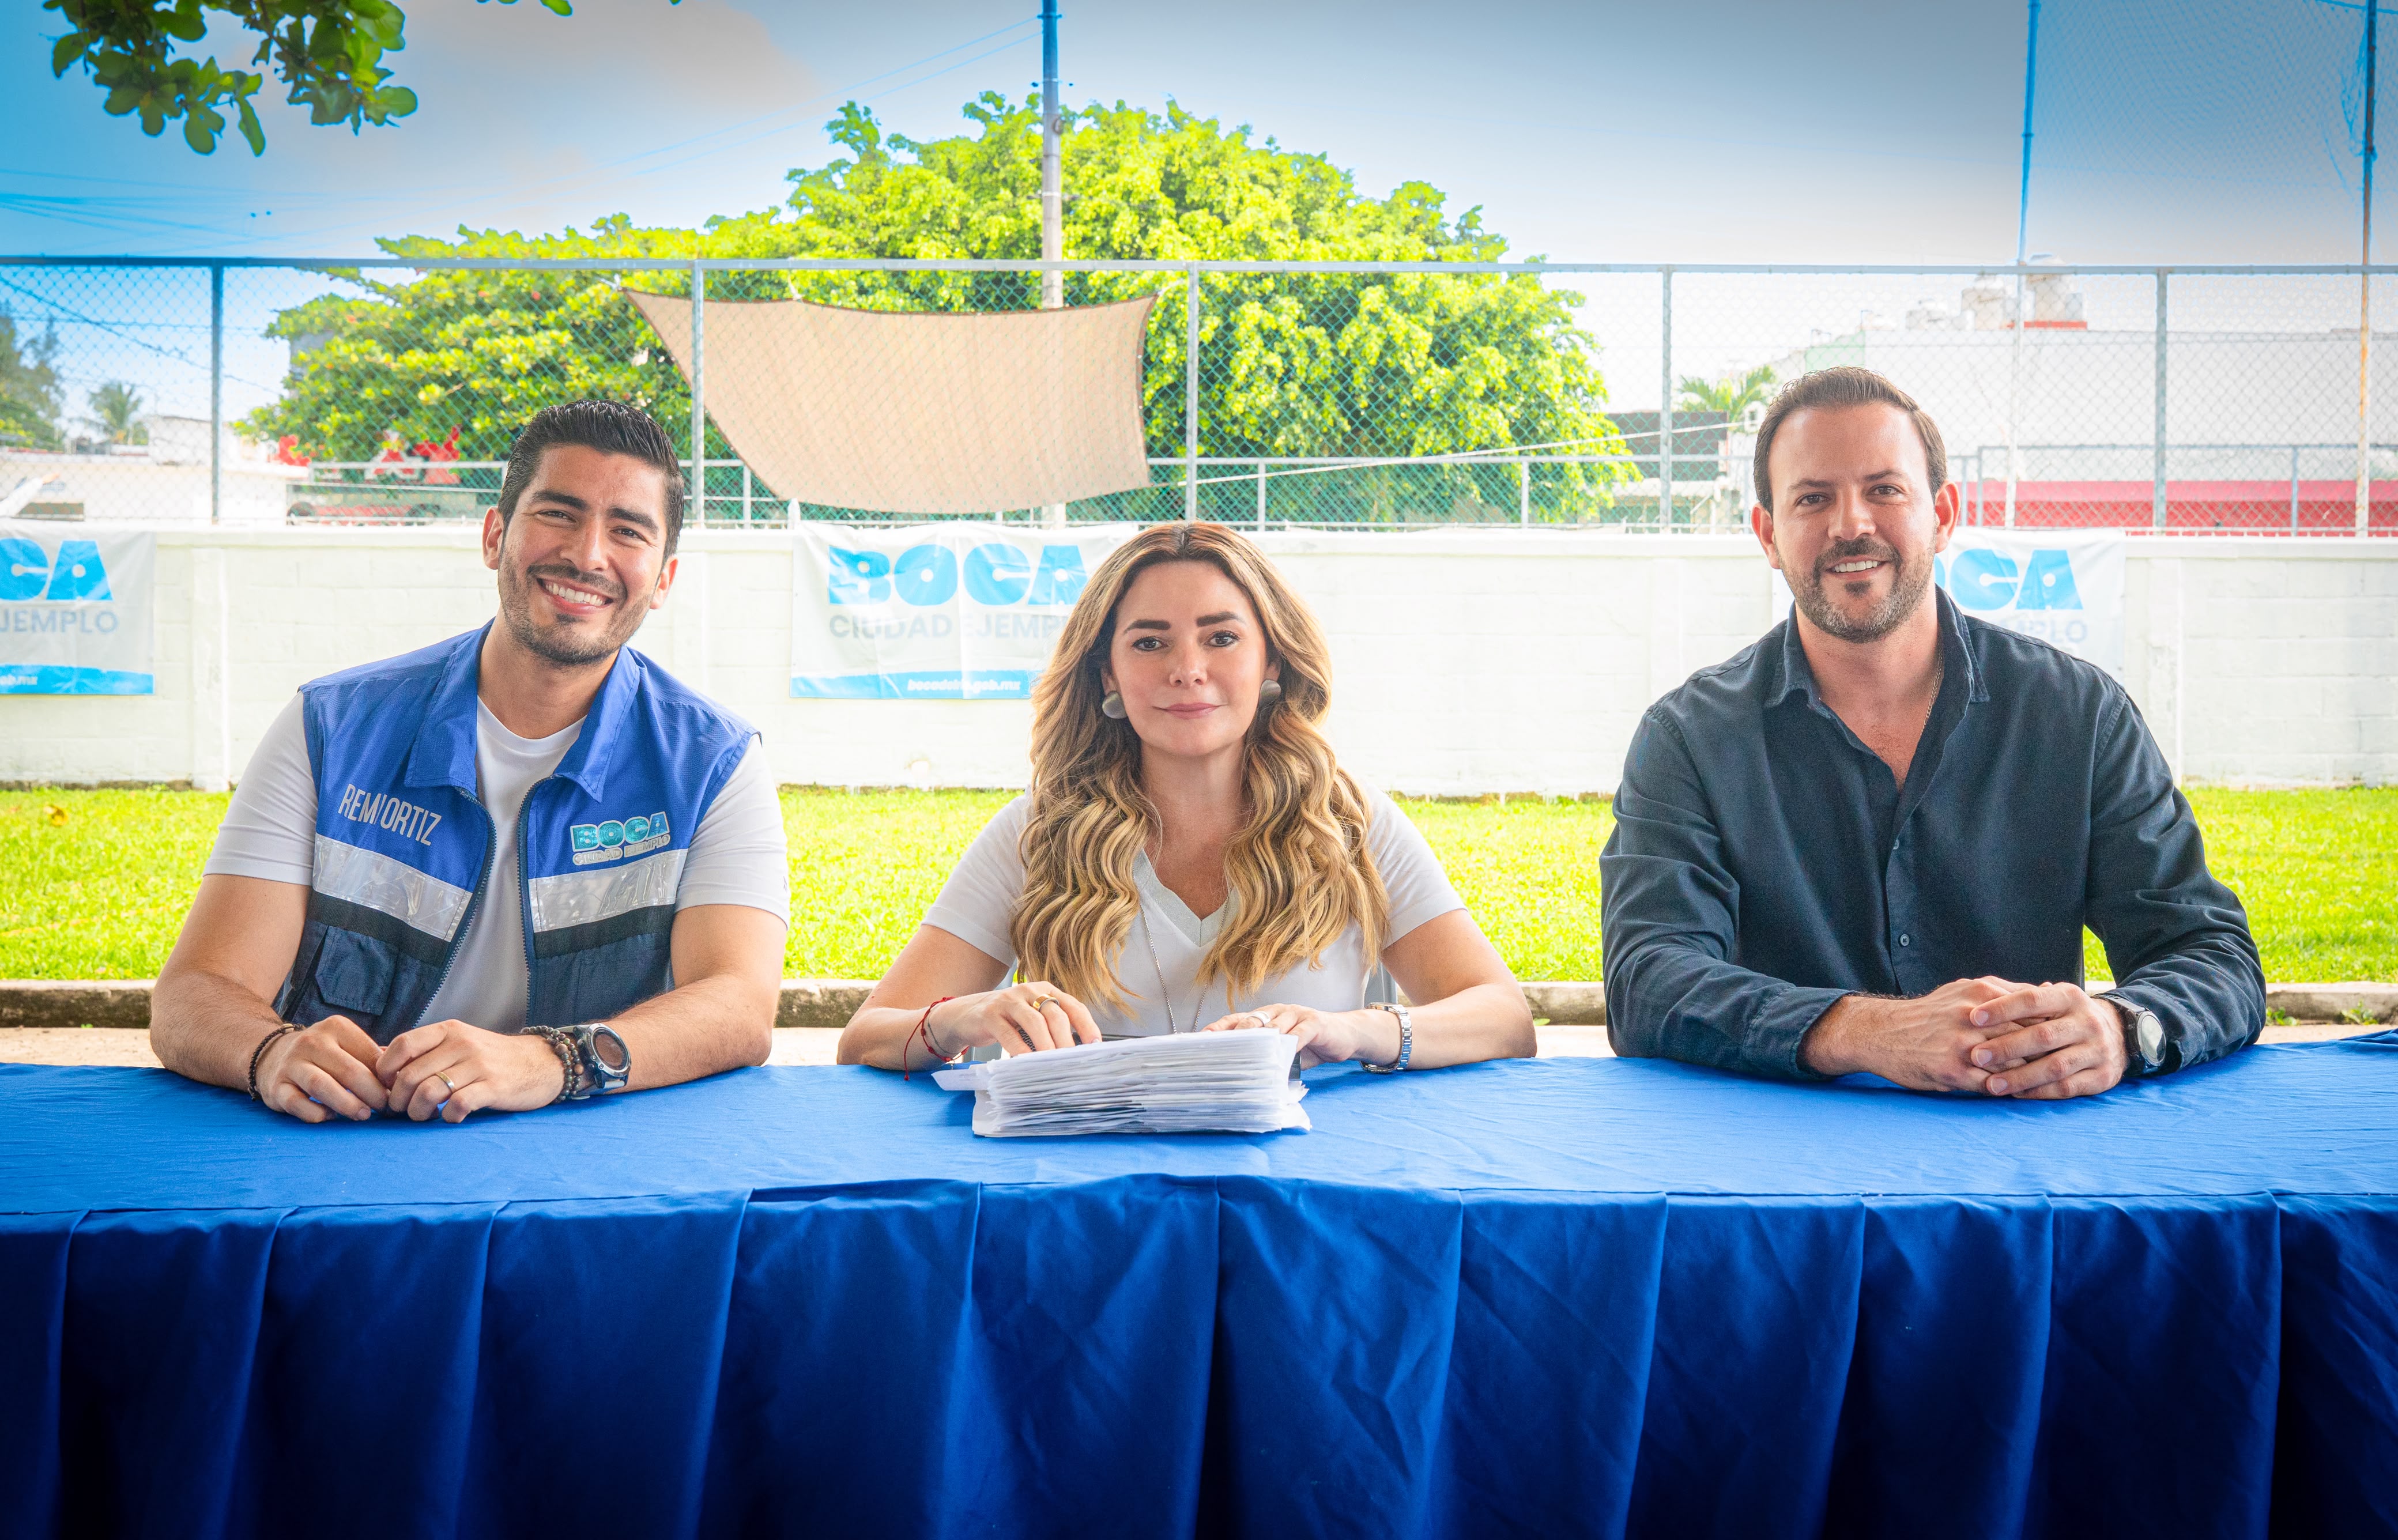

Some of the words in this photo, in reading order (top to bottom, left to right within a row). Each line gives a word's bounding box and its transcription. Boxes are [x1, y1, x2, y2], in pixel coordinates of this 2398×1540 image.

[828, 543, 1088, 606] BOCA
[829, 614, 952, 639] CIUDAD
[959, 614, 1069, 638] EJEMP
[380, 797, 442, 846] ORTIZ
[570, 811, 670, 852] BOCA
[572, 847, 623, 865] CIUDAD
[624, 834, 670, 858] EJEMPLO
